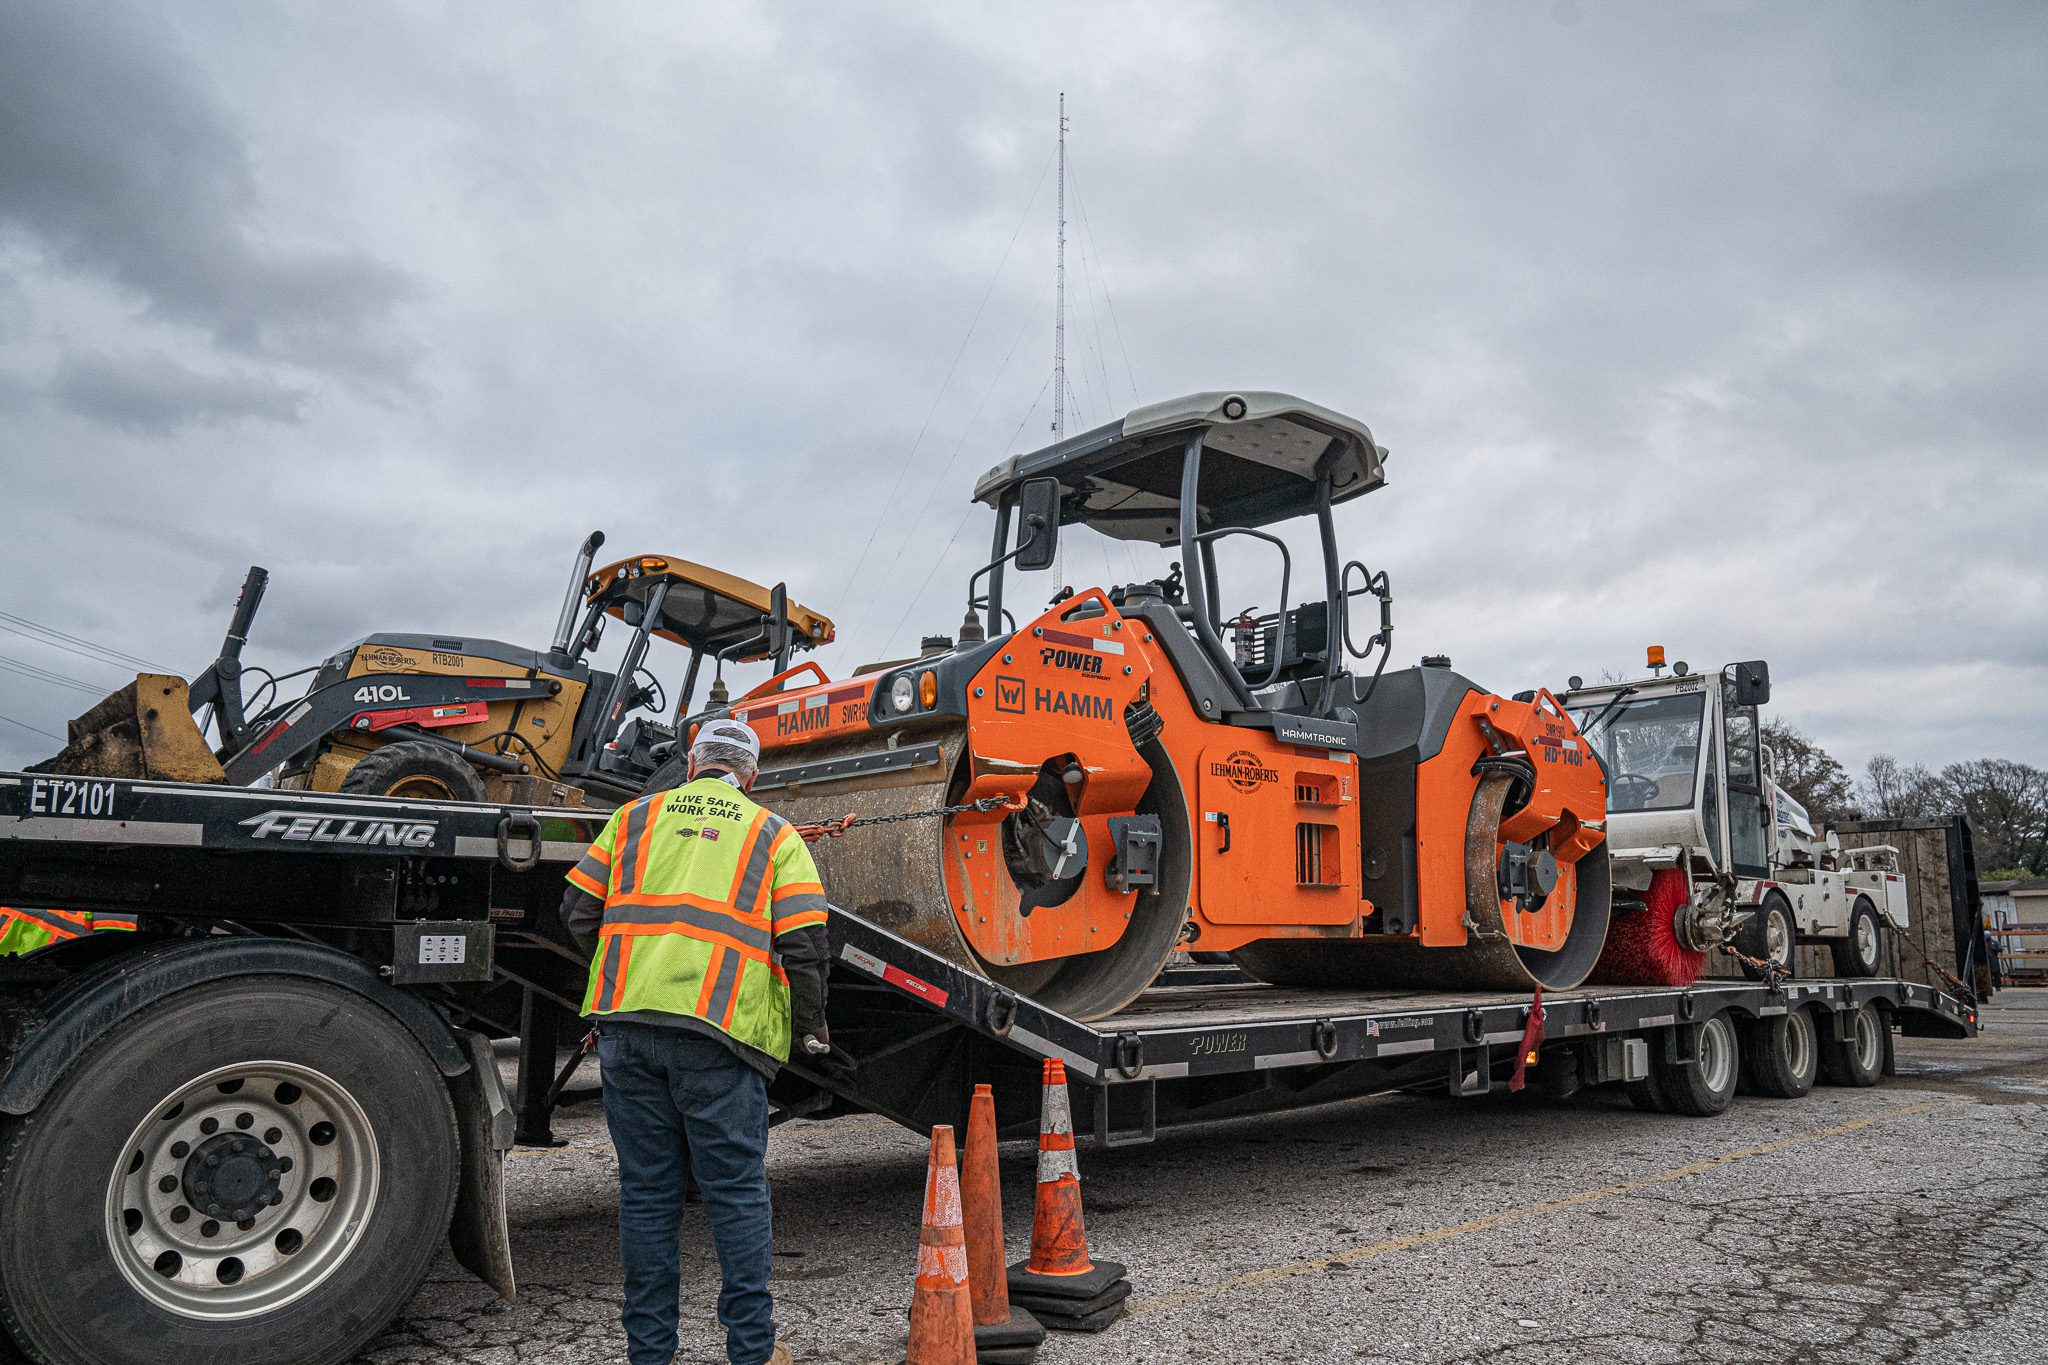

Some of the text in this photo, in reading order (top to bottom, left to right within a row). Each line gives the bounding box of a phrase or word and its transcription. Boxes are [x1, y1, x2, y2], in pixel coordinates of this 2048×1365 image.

[432, 653, 464, 668] RTB2001
[1040, 647, 1103, 675] POWER
[353, 684, 411, 703] 410L
[1035, 687, 1113, 721] HAMM
[777, 705, 830, 736] HAMM
[1282, 728, 1347, 746] HAMMTRONIC
[1210, 762, 1279, 783] LEHMAN-ROBERTS
[30, 778, 116, 816] ET2101
[675, 795, 741, 811] LIVE SAFE
[666, 804, 743, 822] WORK SAFE
[238, 809, 439, 848] FELLING
[1189, 1032, 1247, 1055] POWER
